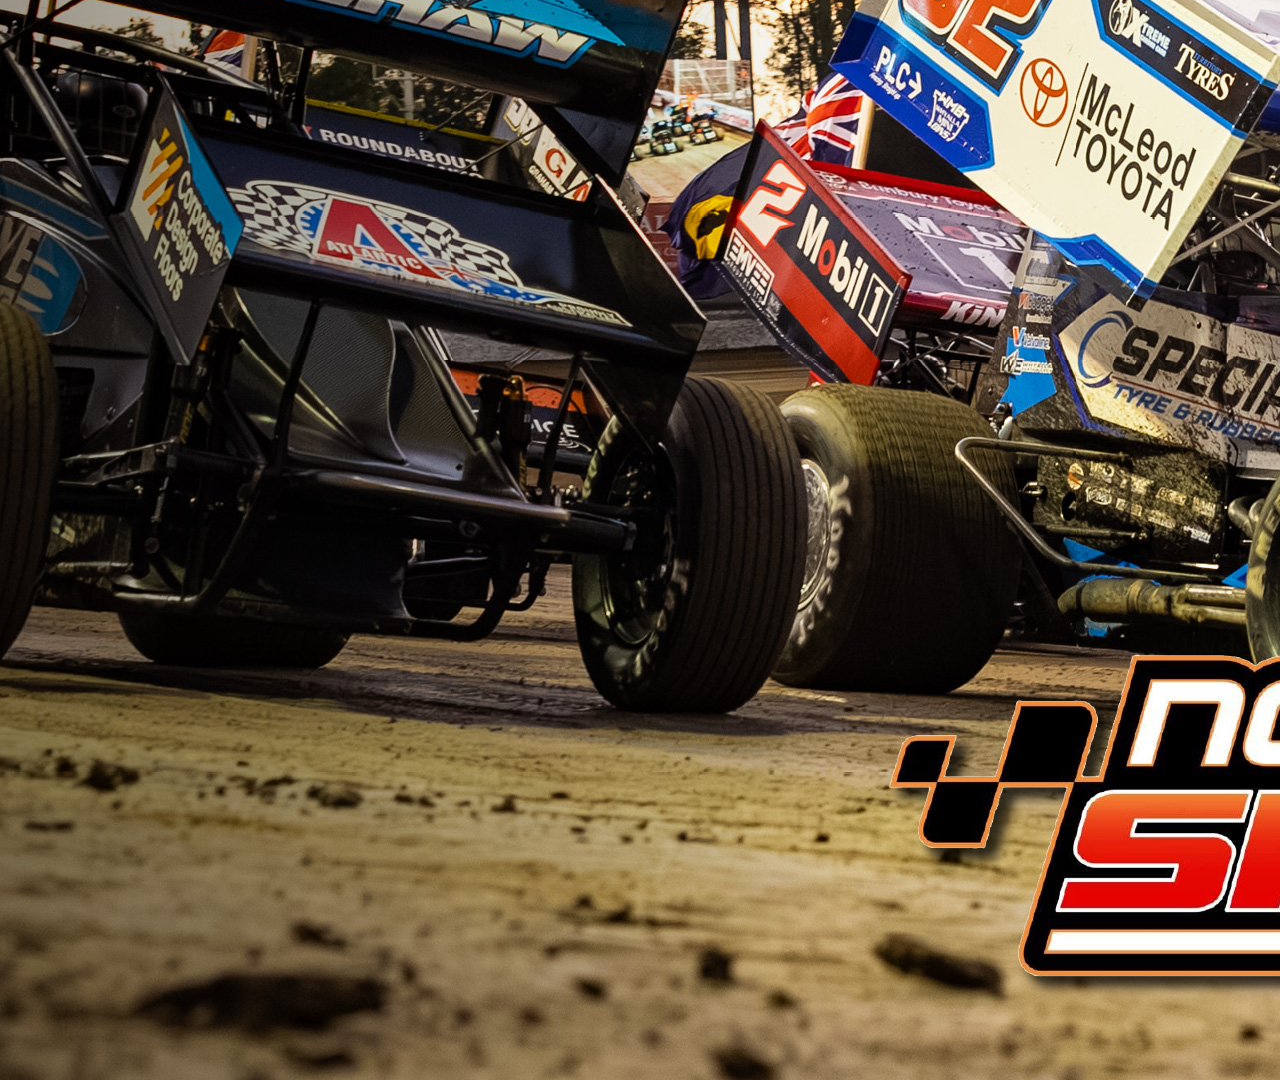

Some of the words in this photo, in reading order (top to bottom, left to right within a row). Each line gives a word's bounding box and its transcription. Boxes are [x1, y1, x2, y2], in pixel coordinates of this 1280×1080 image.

[874, 44, 912, 92] PLC
[1174, 42, 1236, 102] TYRES
[318, 127, 480, 172] ROUNDABOUT
[1079, 73, 1197, 191] McLeod
[737, 160, 807, 250] 2
[1073, 120, 1175, 231] TOYOTA
[164, 204, 199, 276] Design
[177, 170, 225, 266] Corporate
[893, 211, 1027, 252] Mobil
[153, 233, 184, 302] Floors
[325, 238, 423, 272] ATLANTIC
[796, 203, 870, 310] Mobil
[1113, 381, 1172, 416] TYRE
